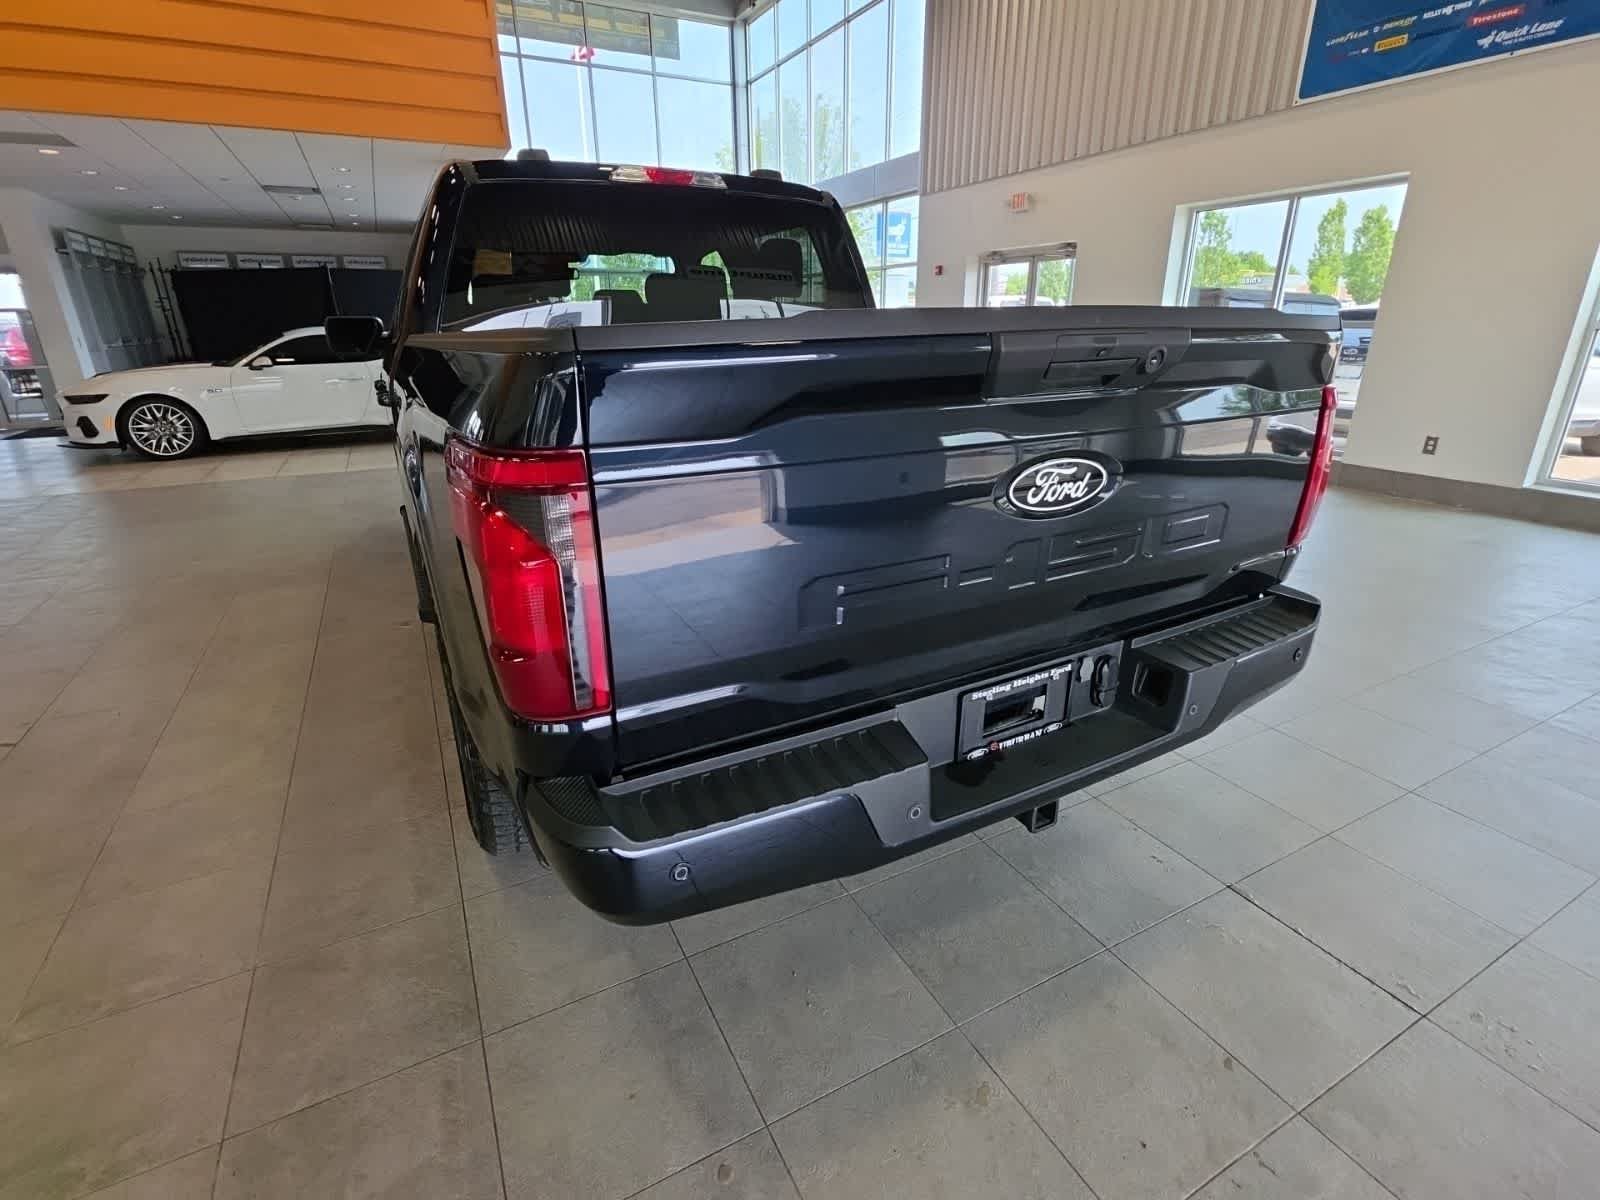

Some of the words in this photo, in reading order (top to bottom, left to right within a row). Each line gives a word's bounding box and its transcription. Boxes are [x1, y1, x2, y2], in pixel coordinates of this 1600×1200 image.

[1494, 24, 1529, 43] Quick
[1530, 17, 1566, 34] Lane
[1026, 465, 1089, 503] Ford
[1013, 671, 1049, 688] Heights
